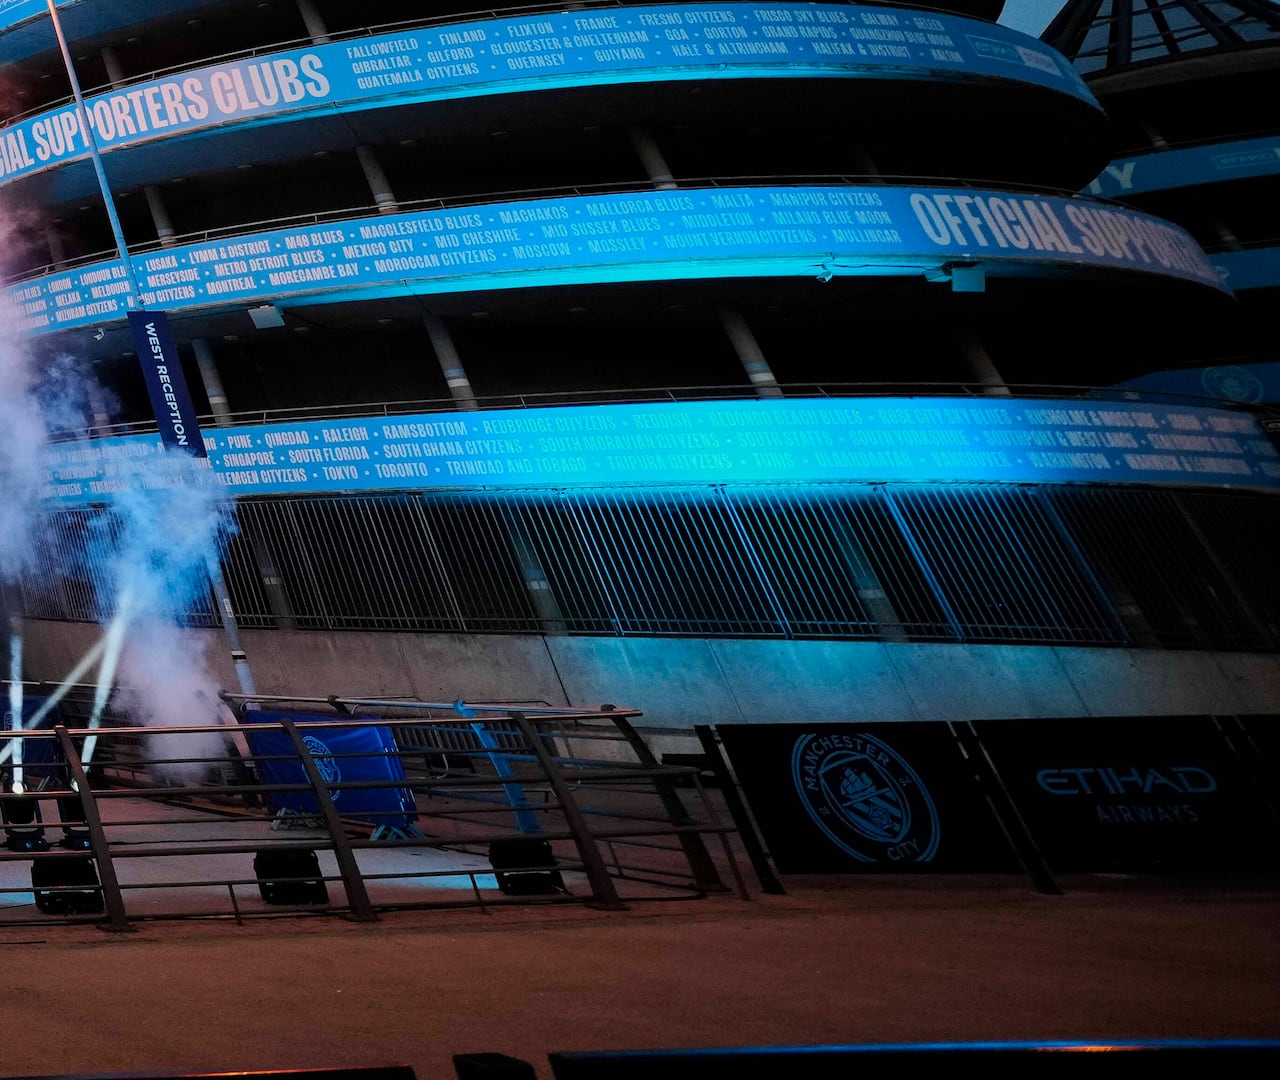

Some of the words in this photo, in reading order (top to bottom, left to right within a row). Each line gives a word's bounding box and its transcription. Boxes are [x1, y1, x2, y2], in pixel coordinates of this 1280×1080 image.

[346, 38, 418, 60] FALLOWFIELD
[440, 29, 486, 46] FINLAND
[575, 16, 620, 32] FRANCE
[352, 56, 412, 74] GIBRALTAR
[426, 47, 475, 63] GILFORD
[491, 37, 562, 56] GLOUCESTER
[210, 53, 332, 120] CLUBS
[357, 68, 423, 90] GUATEMALA
[910, 192, 1084, 254] OFFICIAL
[145, 256, 178, 272] LUSAKA
[312, 231, 344, 246] BLUES
[445, 213, 482, 230] BLUES
[147, 270, 200, 288] MERSEYSIDE
[214, 261, 247, 276] METRO
[248, 254, 290, 272] DETROIT
[292, 250, 324, 265] BLUES
[342, 243, 386, 259] MEXICO
[388, 239, 414, 253] CITY
[434, 234, 460, 249] MID
[206, 276, 257, 295] MONTREAL
[338, 262, 360, 278] BAY
[145, 322, 164, 362] WEST
[156, 365, 188, 446] RECEPTION
[322, 428, 369, 442] RALEIGH
[224, 452, 276, 469] SINGAPORE
[289, 448, 323, 465] SOUTH
[324, 445, 370, 461] FLORIDA
[382, 442, 422, 458] SOUTH
[424, 440, 462, 456] GHANA
[322, 466, 358, 480] TOKYO
[375, 463, 428, 478] TORONTO
[802, 736, 890, 791] MANCHESTER
[1036, 766, 1218, 796] ETIHAD
[1096, 803, 1198, 823] AIRWAYS
[886, 838, 920, 861] CITY
